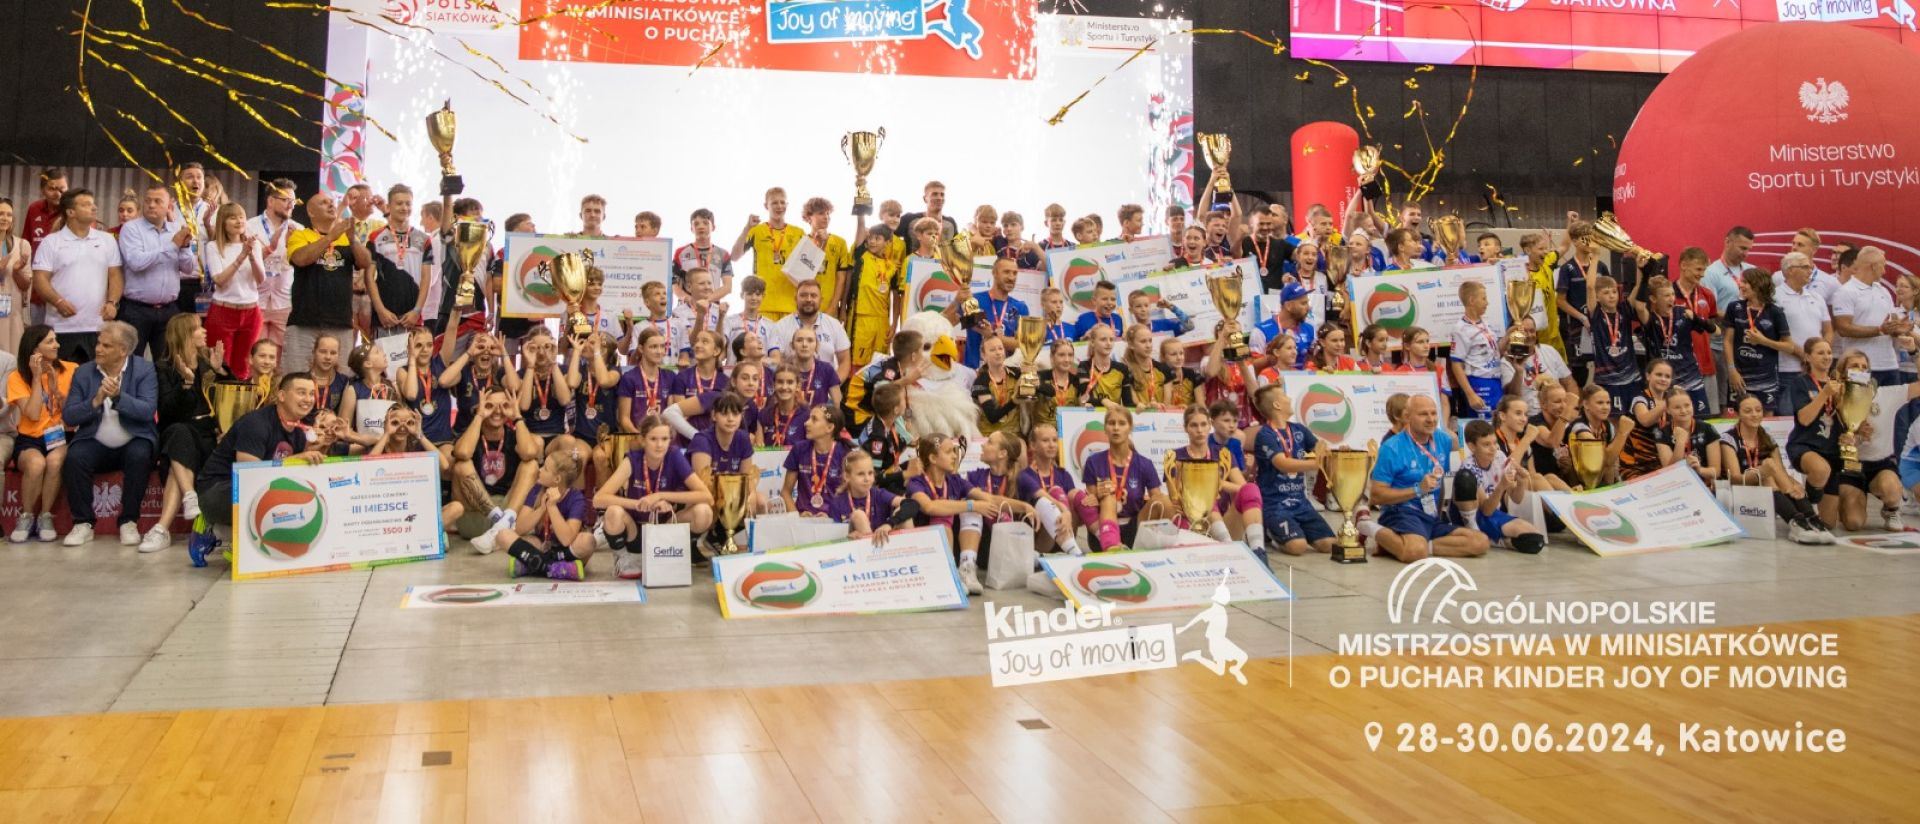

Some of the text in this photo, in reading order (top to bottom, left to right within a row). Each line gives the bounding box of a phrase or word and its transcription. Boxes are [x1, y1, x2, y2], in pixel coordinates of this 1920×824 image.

[426, 11, 499, 24] SIATKÓWKA
[1782, 0, 1806, 20] Joy
[1826, 0, 1872, 14] moving
[777, 9, 815, 35] Joy
[820, 6, 841, 29] of
[644, 26, 660, 40] O
[1769, 143, 1896, 163] Ministerstwo
[1748, 166, 1920, 193] Sportu i Turystyki
[1613, 396, 1623, 411] 4
[352, 501, 409, 514] III MIEJSCE
[382, 527, 403, 535] 3500
[1279, 521, 1289, 536] 7
[653, 545, 684, 557] Gerflor
[852, 565, 920, 582] MIEJSCE
